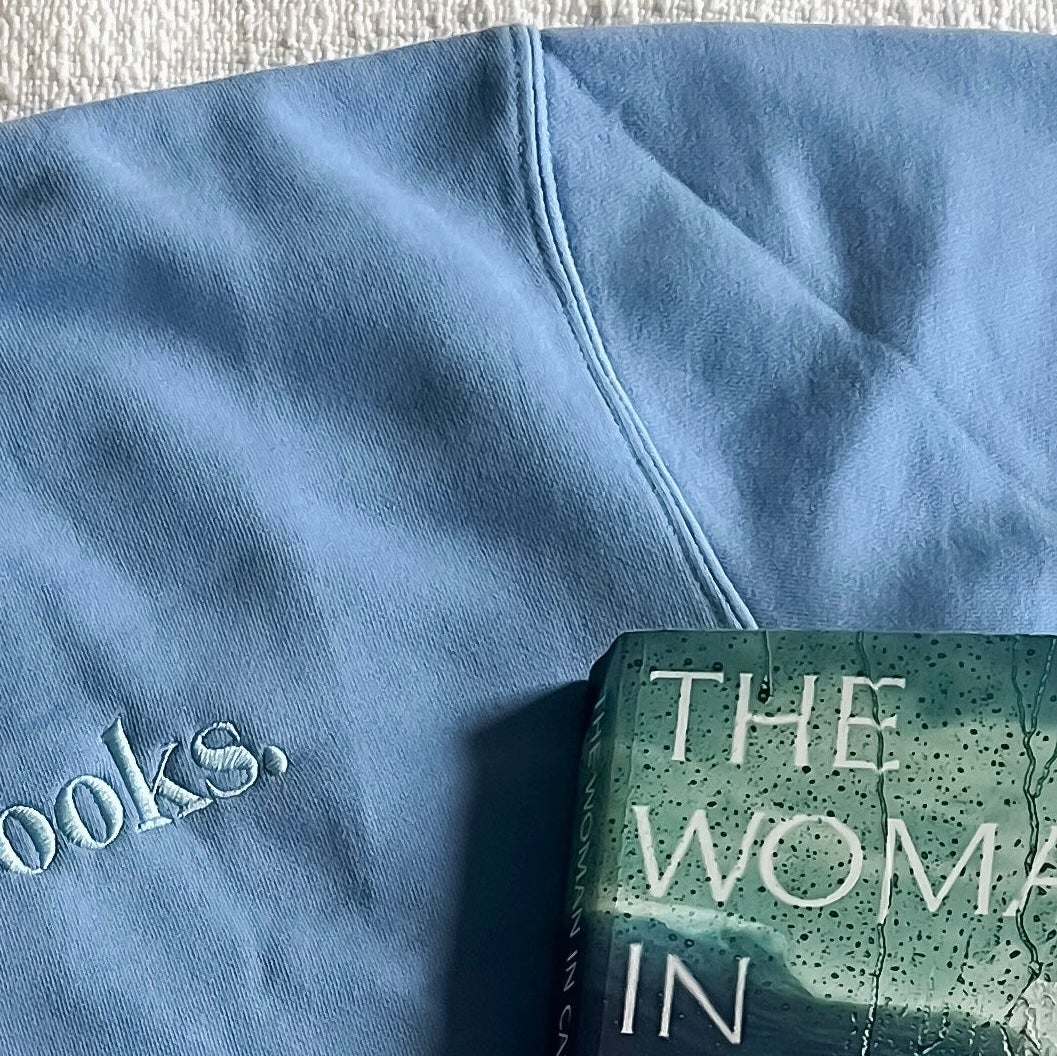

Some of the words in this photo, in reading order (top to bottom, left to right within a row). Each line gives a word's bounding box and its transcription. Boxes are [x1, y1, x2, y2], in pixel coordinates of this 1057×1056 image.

[587, 696, 606, 762] THE
[650, 670, 907, 772] THE
[569, 775, 598, 939] WOMAN
[563, 948, 577, 992] IN
[620, 942, 751, 1045] IN
